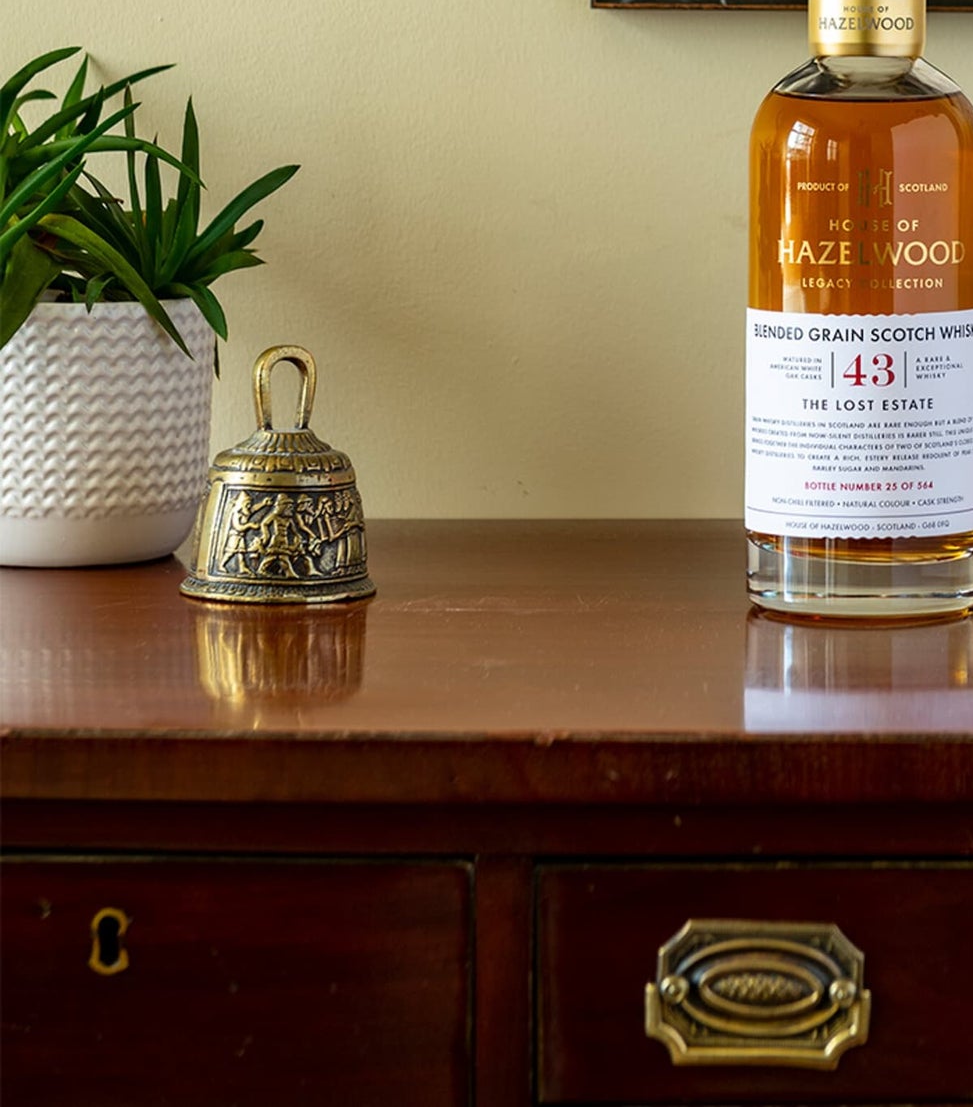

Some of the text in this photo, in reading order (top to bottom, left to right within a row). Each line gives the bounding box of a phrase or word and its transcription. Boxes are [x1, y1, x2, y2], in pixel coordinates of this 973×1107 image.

[819, 17, 914, 30] HAZELWOOD
[797, 182, 948, 192] PRODUCT OF SCOTLAND
[829, 219, 919, 231] HOUSE OF
[778, 240, 965, 265] HAZELWOOD
[802, 278, 943, 288] LEGACY OLLECTION
[755, 324, 803, 340] BLENDED
[809, 328, 864, 342] GRAIN
[871, 327, 935, 342] SCOTCH
[843, 354, 895, 386] 43
[803, 398, 933, 411] THE LOST ESTATE
[804, 481, 933, 491] BOTTLE NUMBER 25 OF 564
[806, 499, 835, 507] FILTERED
[880, 500, 910, 508] COLOUR
[917, 498, 935, 506] CASK
[821, 523, 870, 531] HAZELWOOD
[877, 522, 915, 530] SCOTLAND
